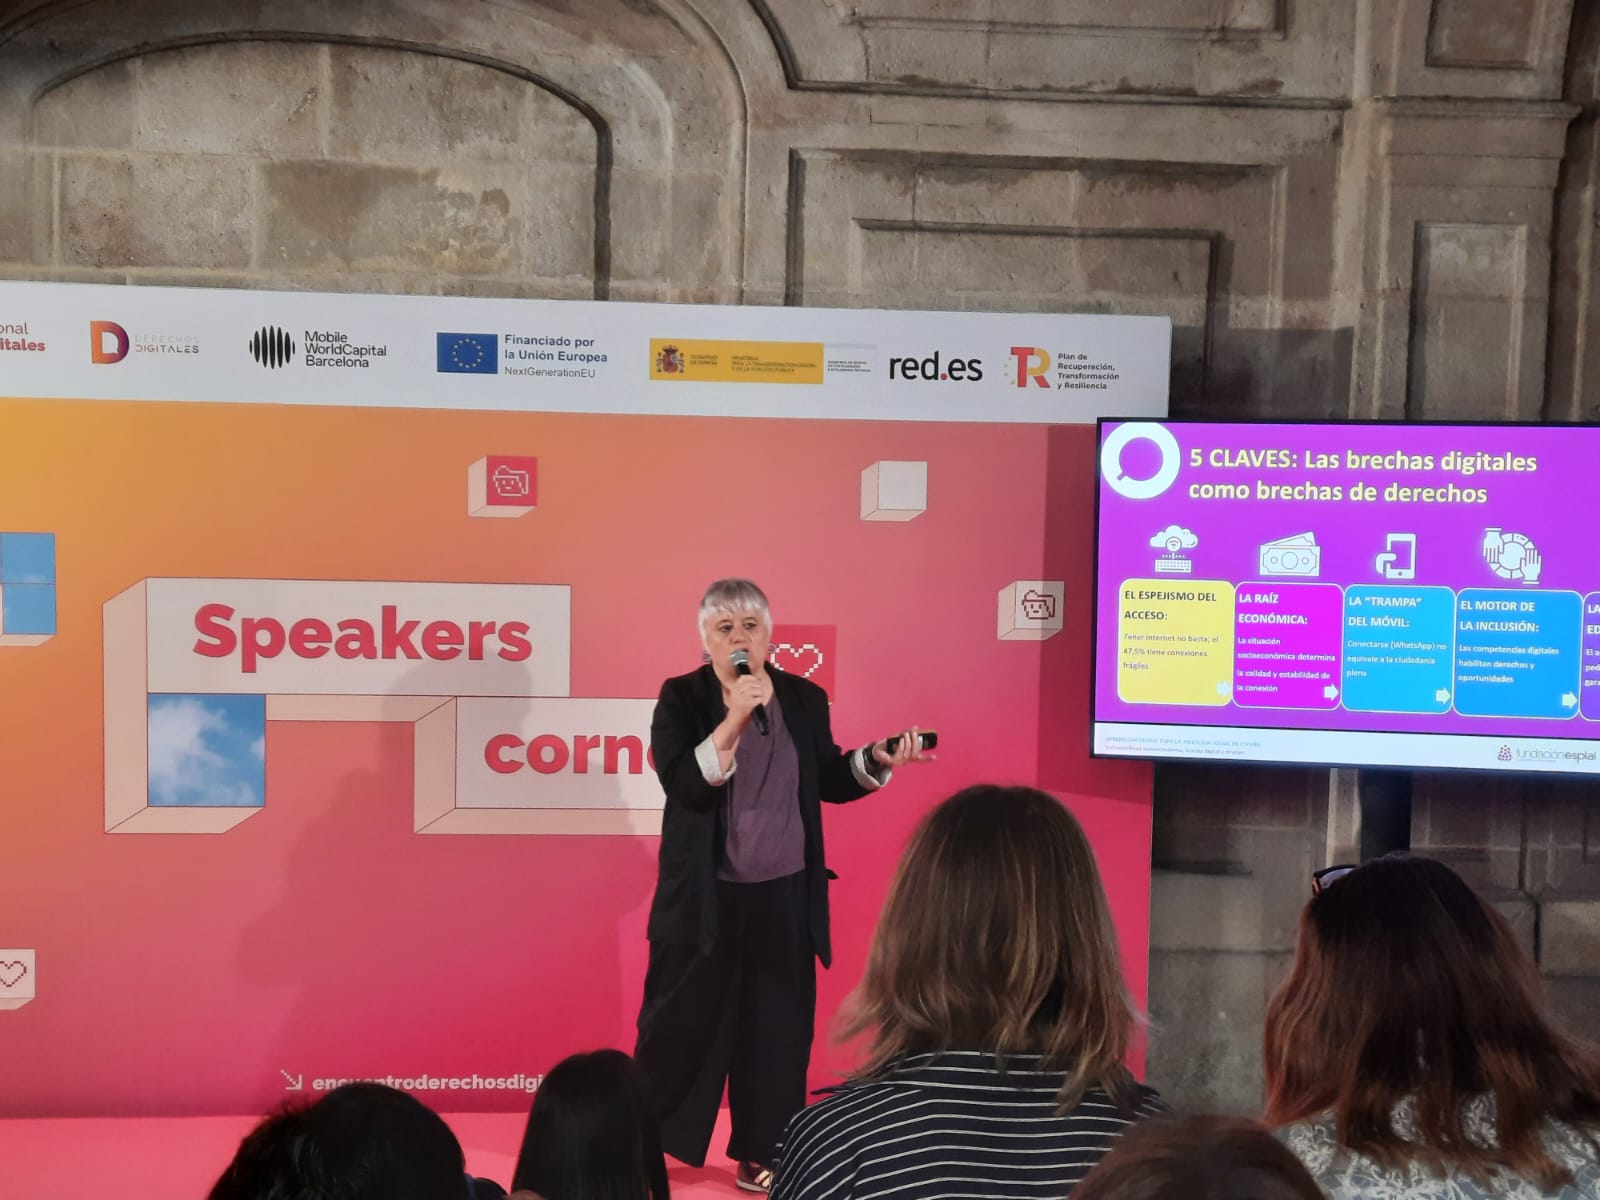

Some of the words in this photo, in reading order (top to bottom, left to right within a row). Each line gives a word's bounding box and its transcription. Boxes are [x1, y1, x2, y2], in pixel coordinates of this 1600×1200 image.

[304, 330, 348, 343] Mobile
[504, 334, 571, 347] Financiado
[574, 339, 595, 349] por
[135, 344, 200, 354] DIGITALES
[304, 343, 387, 358] WorldCapital
[305, 355, 369, 368] Barcelona
[504, 349, 515, 360] la
[518, 350, 554, 361] Unión
[558, 351, 608, 364] Europea
[1058, 352, 1076, 361] Plan
[1077, 353, 1088, 361] de
[889, 350, 983, 381] red.es
[1057, 362, 1116, 372] Recuperación,
[504, 366, 596, 379] NextGenerationEU
[1057, 371, 1120, 381] Transformación
[1057, 382, 1063, 390] y
[1064, 382, 1108, 391] Resiliencia
[1190, 449, 1203, 467] 5
[1209, 449, 1298, 469] CLAVES:
[1304, 451, 1340, 470] Las
[1346, 450, 1435, 471] brechas
[1440, 451, 1538, 476] digitales
[1188, 482, 1250, 500] como
[1257, 480, 1343, 501] brechas
[1350, 481, 1378, 502] de
[1383, 482, 1488, 503] derechos
[1125, 590, 1136, 600] EL
[1138, 590, 1195, 601] ESPEJISMO
[1197, 592, 1217, 602] DEL
[1239, 593, 1252, 603] LA
[1254, 592, 1279, 604] RAÍZ
[1349, 596, 1362, 606] LA
[1460, 600, 1473, 611] EL
[1475, 601, 1517, 611] MOTOR
[1520, 602, 1536, 612] DE
[1124, 610, 1168, 620] ACCESO:
[1238, 612, 1308, 625] ECONÓMICA:
[1348, 616, 1368, 627] DEL
[1370, 615, 1410, 628] MÓVIL:
[1460, 621, 1474, 631] LA
[1476, 620, 1540, 633] INCLUSIÓN:
[193, 603, 534, 674] Speakers
[1124, 633, 1144, 641] Tener
[1146, 634, 1175, 642] internet
[1238, 637, 1246, 645] La
[1347, 640, 1389, 649] Conectarse
[1390, 641, 1435, 651] (WhatsApp)
[1436, 643, 1447, 651] no
[1473, 645, 1526, 655] competencias
[1527, 647, 1560, 656] digitales
[1147, 648, 1166, 656] tiene
[1297, 653, 1336, 662] determina
[1586, 648, 1593, 656] El
[1347, 655, 1379, 664] equivale
[1386, 656, 1393, 664] la
[1458, 659, 1492, 668] habilitan
[1493, 660, 1529, 669] derechos
[1529, 662, 1535, 671] y
[1237, 669, 1244, 677] la
[1245, 669, 1272, 678] calidad
[1272, 671, 1278, 679] y
[1279, 671, 1320, 680] estabilidad
[1346, 669, 1368, 678] plena
[1458, 675, 1515, 684] oportunidades
[484, 732, 657, 775] corn
